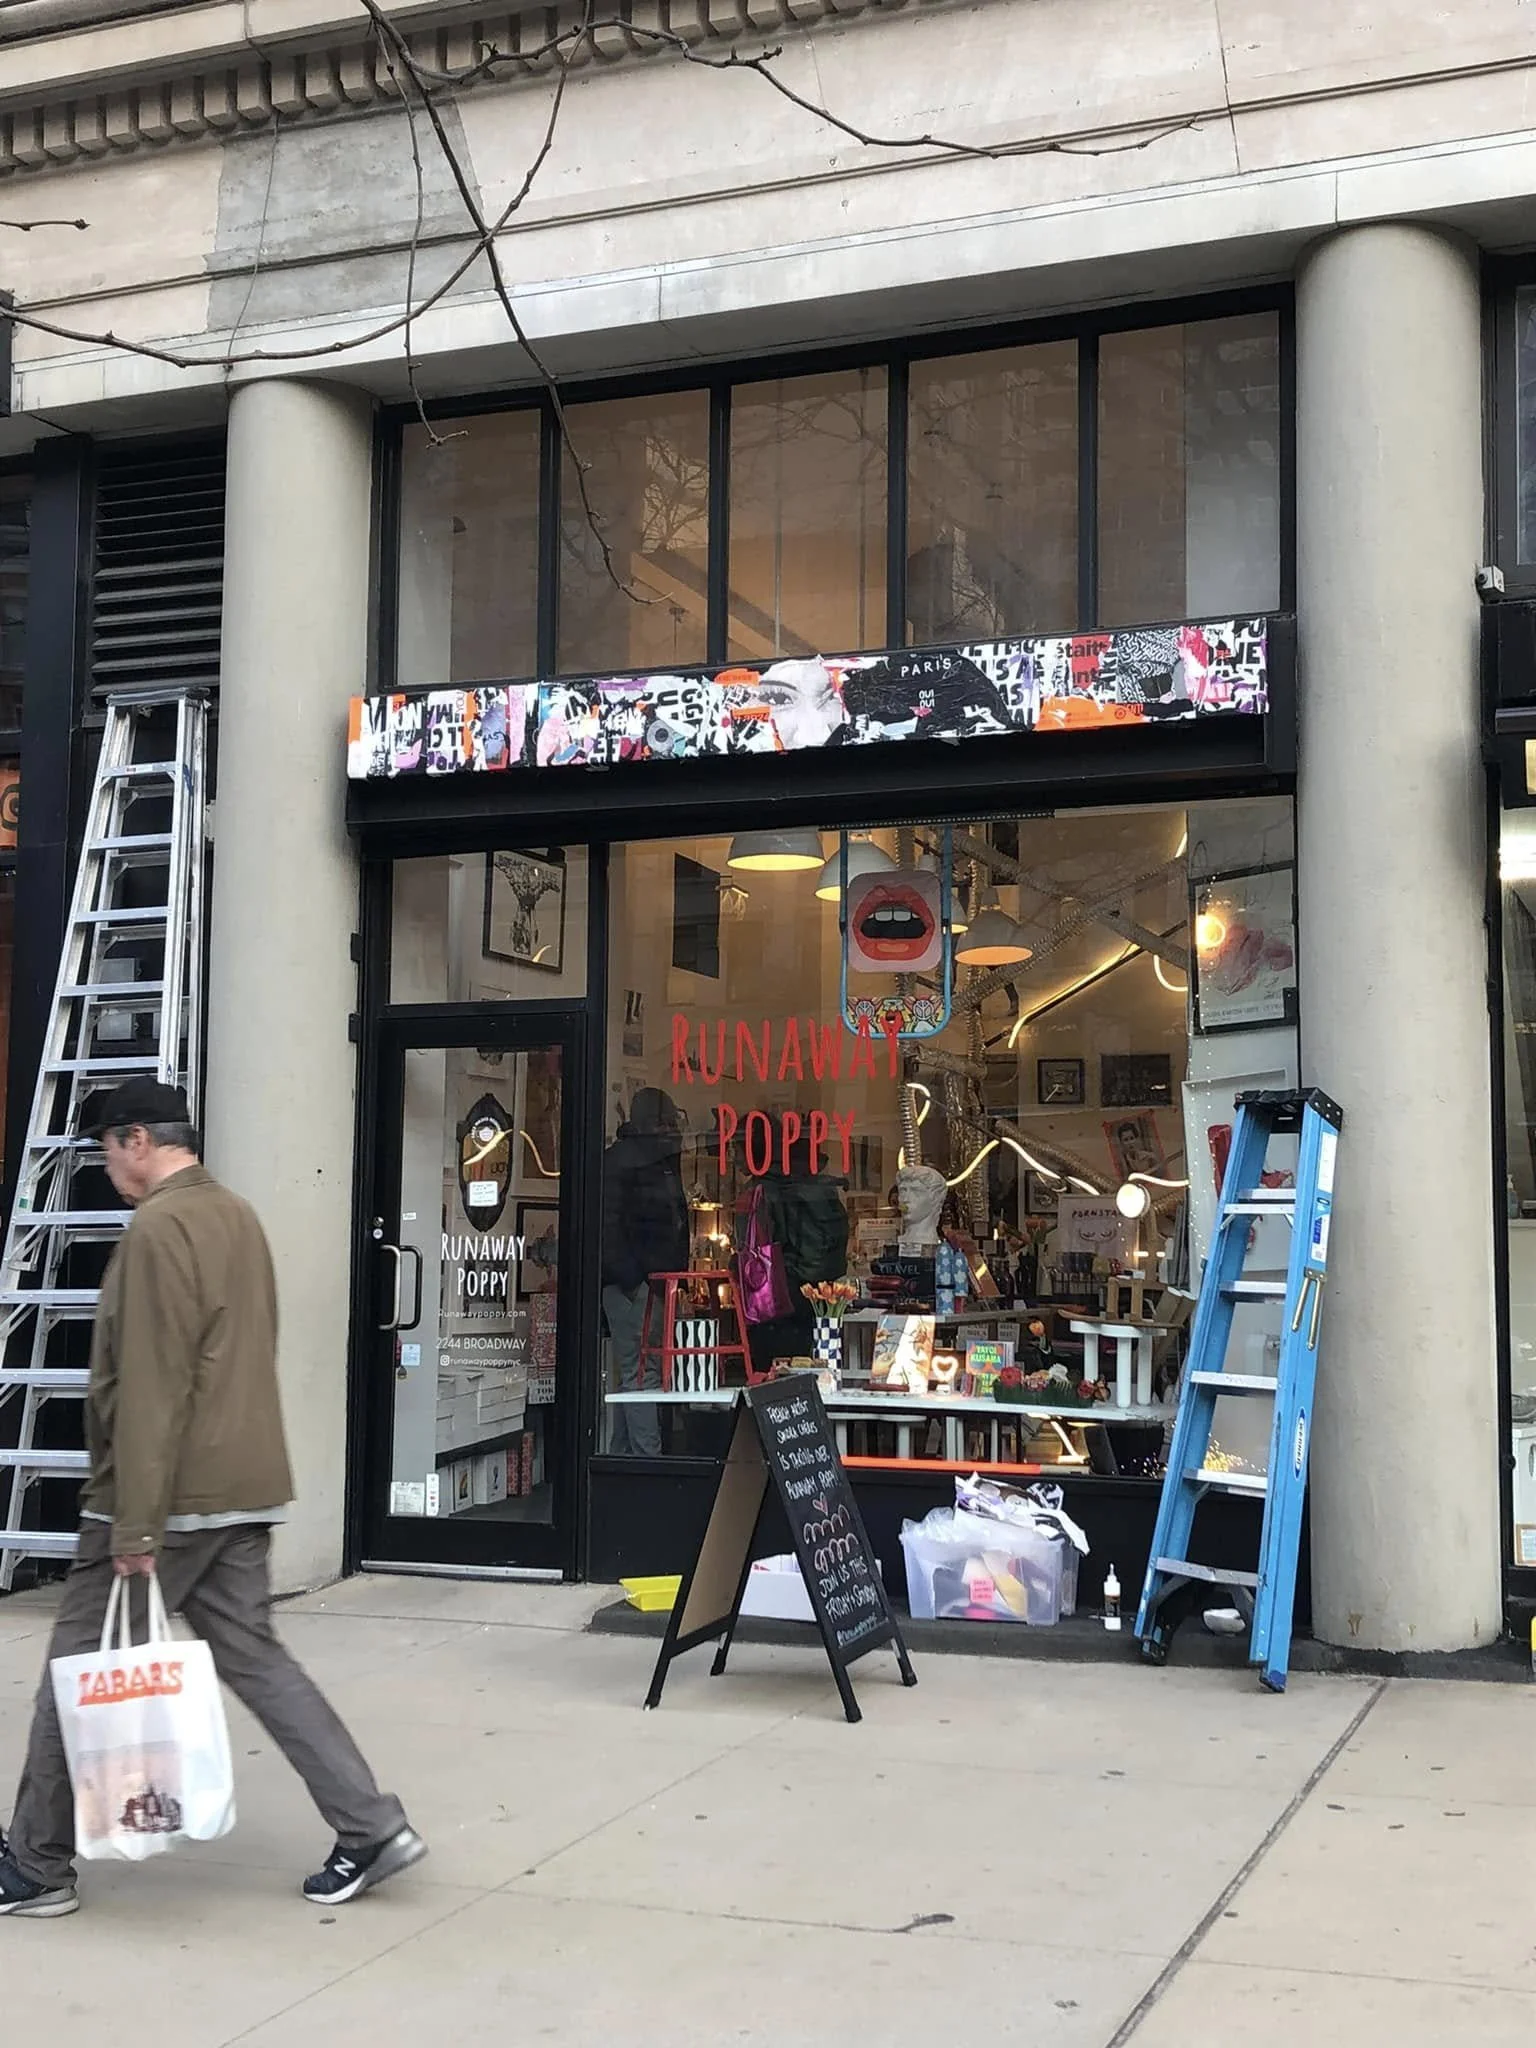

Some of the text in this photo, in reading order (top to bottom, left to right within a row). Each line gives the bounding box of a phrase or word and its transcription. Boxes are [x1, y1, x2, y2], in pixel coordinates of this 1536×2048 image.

[901, 655, 953, 677] PARIS
[918, 689, 935, 699] OUI
[919, 698, 935, 708] OUI
[672, 1013, 905, 1085] RUNAWAY
[718, 1103, 856, 1177] POPPY
[441, 1233, 526, 1262] RUNAWAY
[458, 1268, 508, 1297] POPPY
[436, 1337, 527, 1350] 2244 BROADWAY
[785, 1476, 819, 1500] RUNAWAY
[837, 1563, 851, 1583] US
